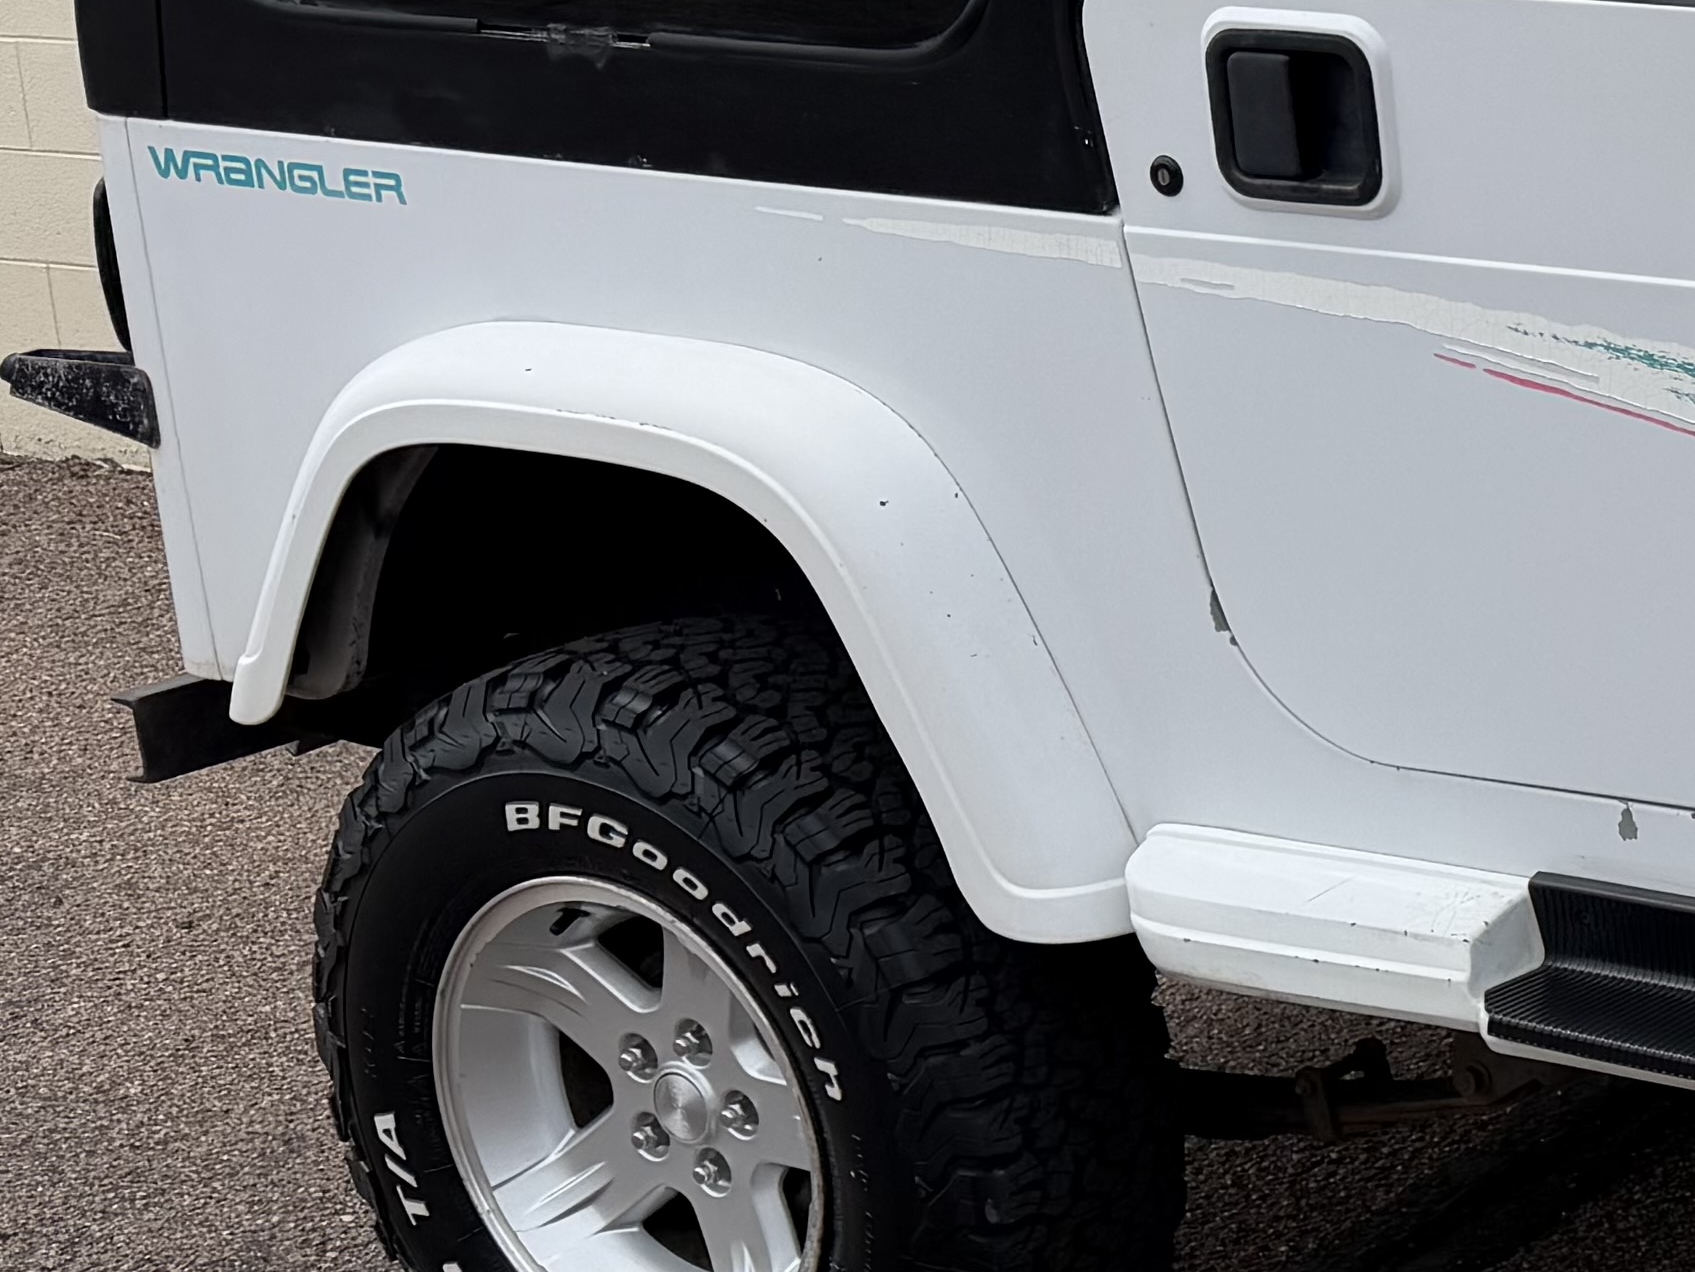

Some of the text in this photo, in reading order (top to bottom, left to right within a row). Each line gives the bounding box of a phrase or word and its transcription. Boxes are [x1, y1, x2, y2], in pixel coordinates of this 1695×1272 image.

[148, 145, 407, 206] WRANGLER
[505, 801, 842, 1101] BFGoodrich
[374, 1112, 430, 1226] T/A
